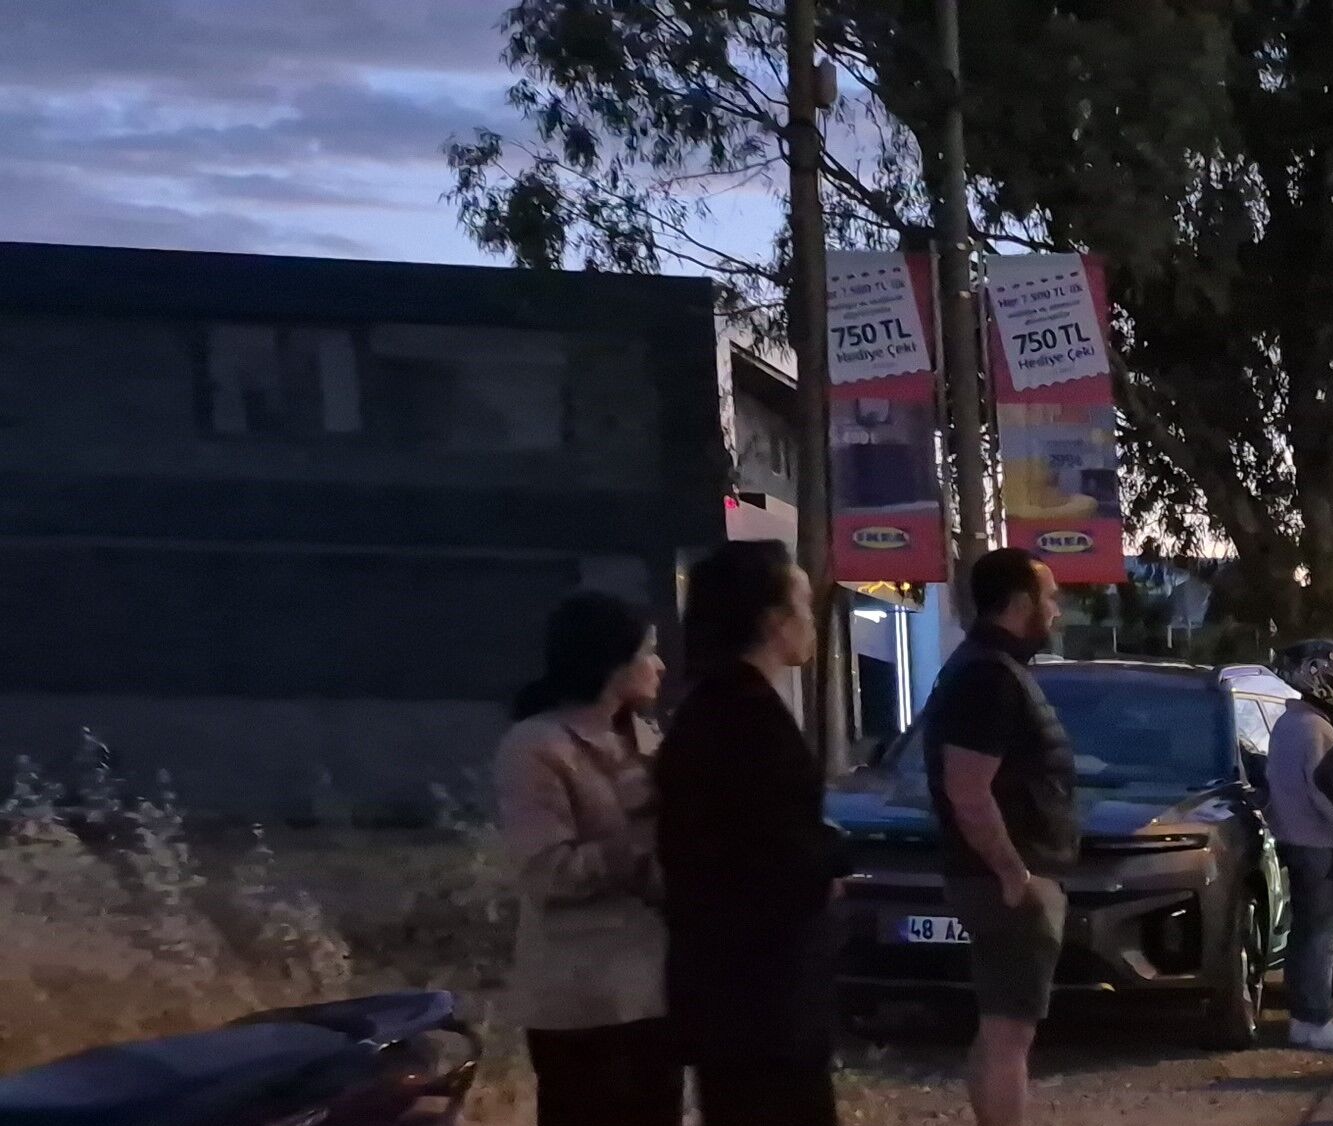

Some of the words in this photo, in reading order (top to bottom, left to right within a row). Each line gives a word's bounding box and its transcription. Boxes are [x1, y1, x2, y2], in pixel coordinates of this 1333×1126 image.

[830, 323, 878, 349] 750
[879, 318, 912, 340] TL
[1012, 328, 1058, 355] 750
[1058, 322, 1091, 345] TL
[1017, 353, 1064, 370] Hediye
[1039, 533, 1090, 548] IKEA
[911, 918, 933, 940] 48
